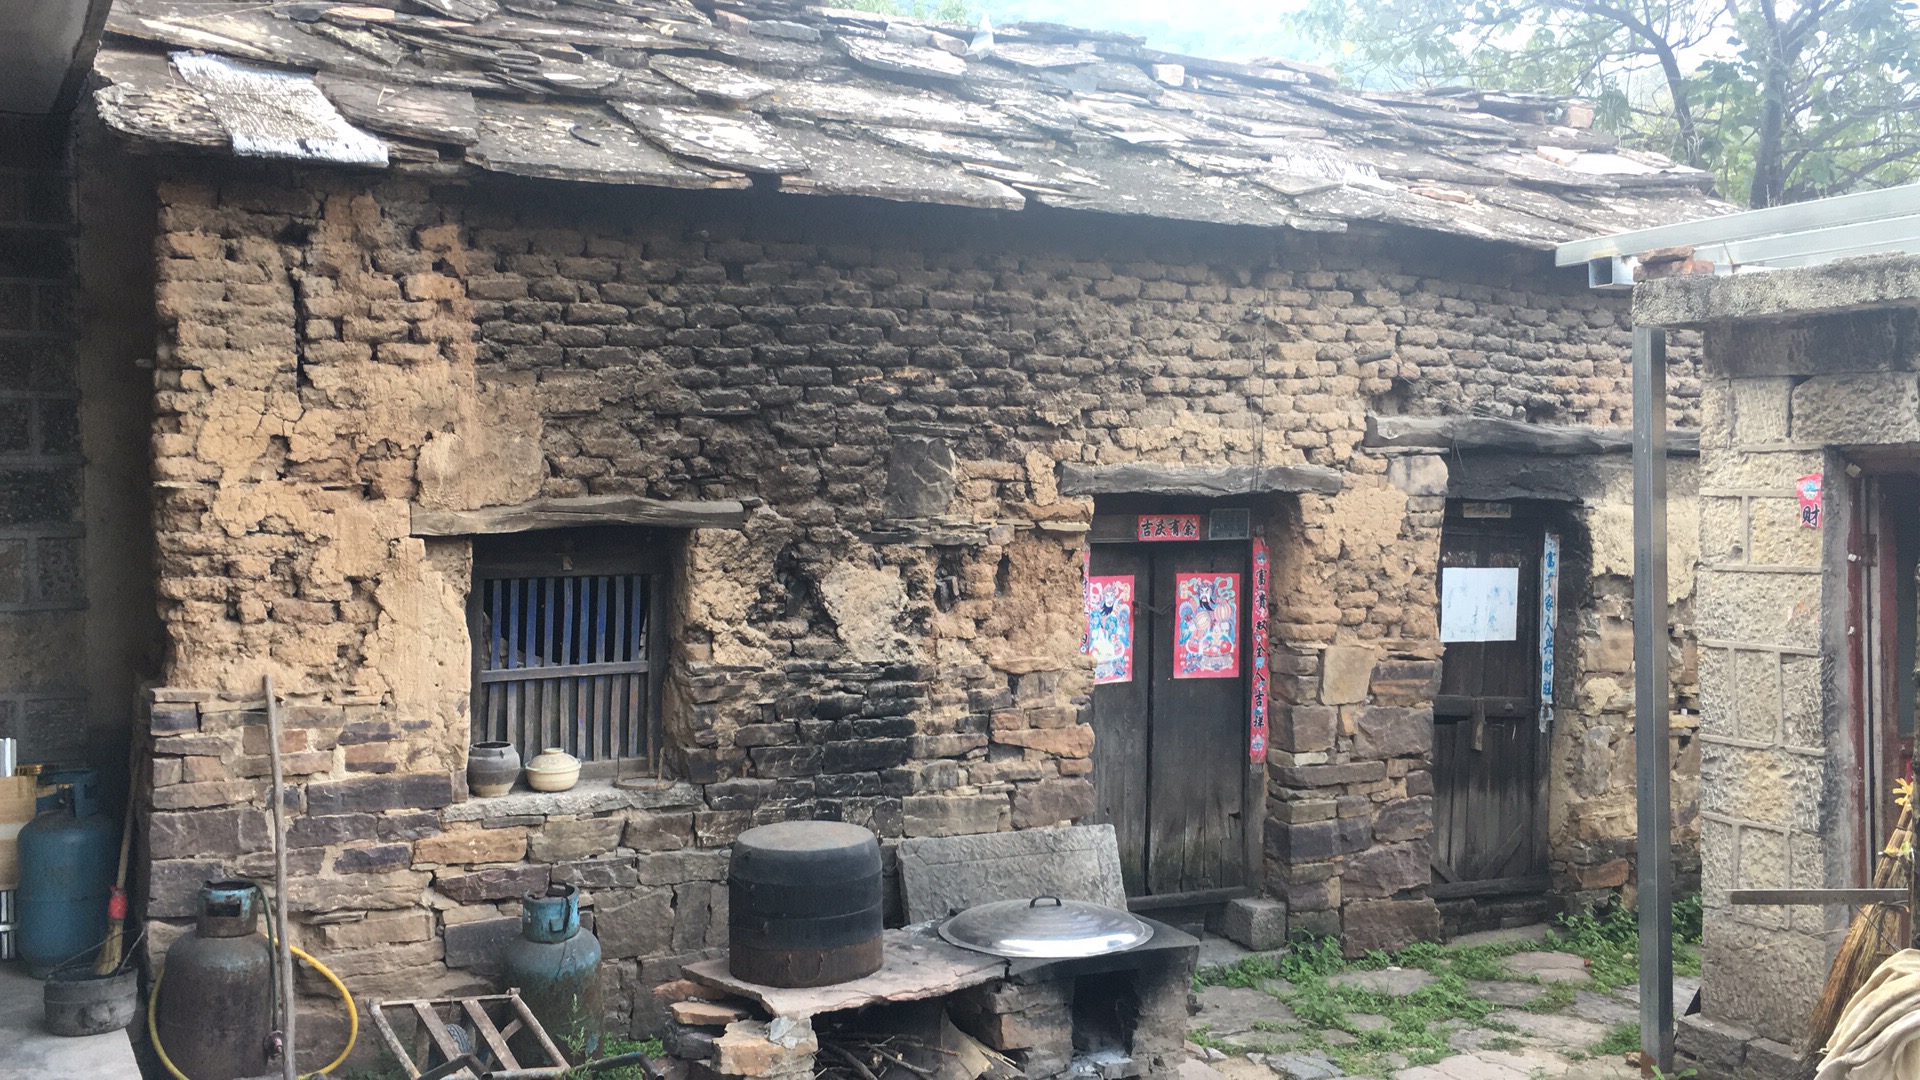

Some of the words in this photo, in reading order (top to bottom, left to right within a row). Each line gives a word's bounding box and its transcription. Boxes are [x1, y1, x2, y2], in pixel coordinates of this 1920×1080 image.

[1802, 503, 1820, 527] 财
[1141, 518, 1197, 537] 吉庆有余
[1253, 568, 1269, 731] 富贵双全人吉祥
